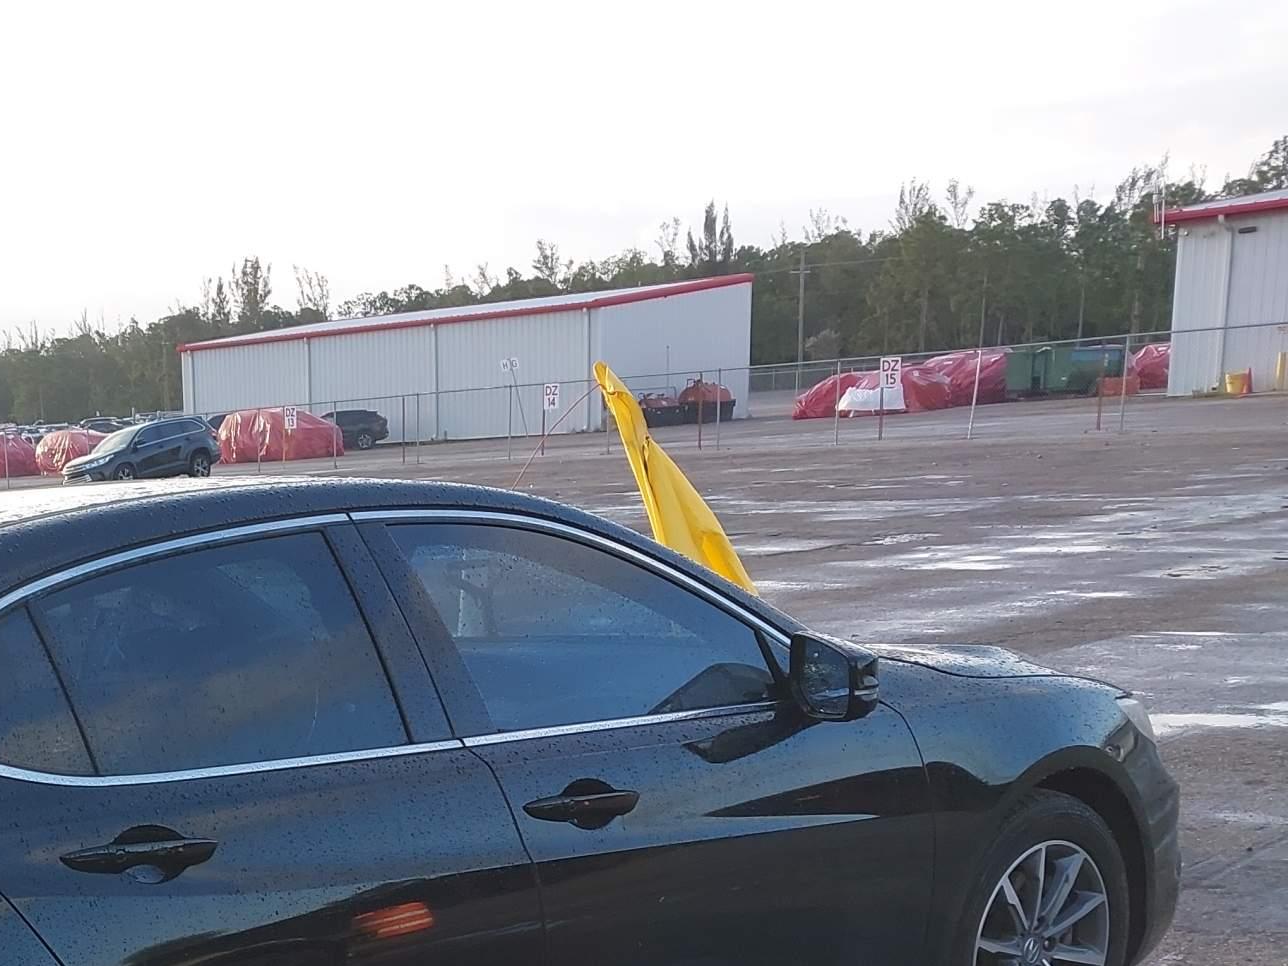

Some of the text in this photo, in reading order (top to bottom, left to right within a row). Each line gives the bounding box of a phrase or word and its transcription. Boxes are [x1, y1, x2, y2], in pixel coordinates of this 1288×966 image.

[882, 359, 900, 372] DZ
[885, 373, 897, 385] 15
[545, 385, 559, 396] DZ
[548, 397, 556, 407] 14
[285, 407, 296, 417] DZ
[288, 418, 295, 427] 13
